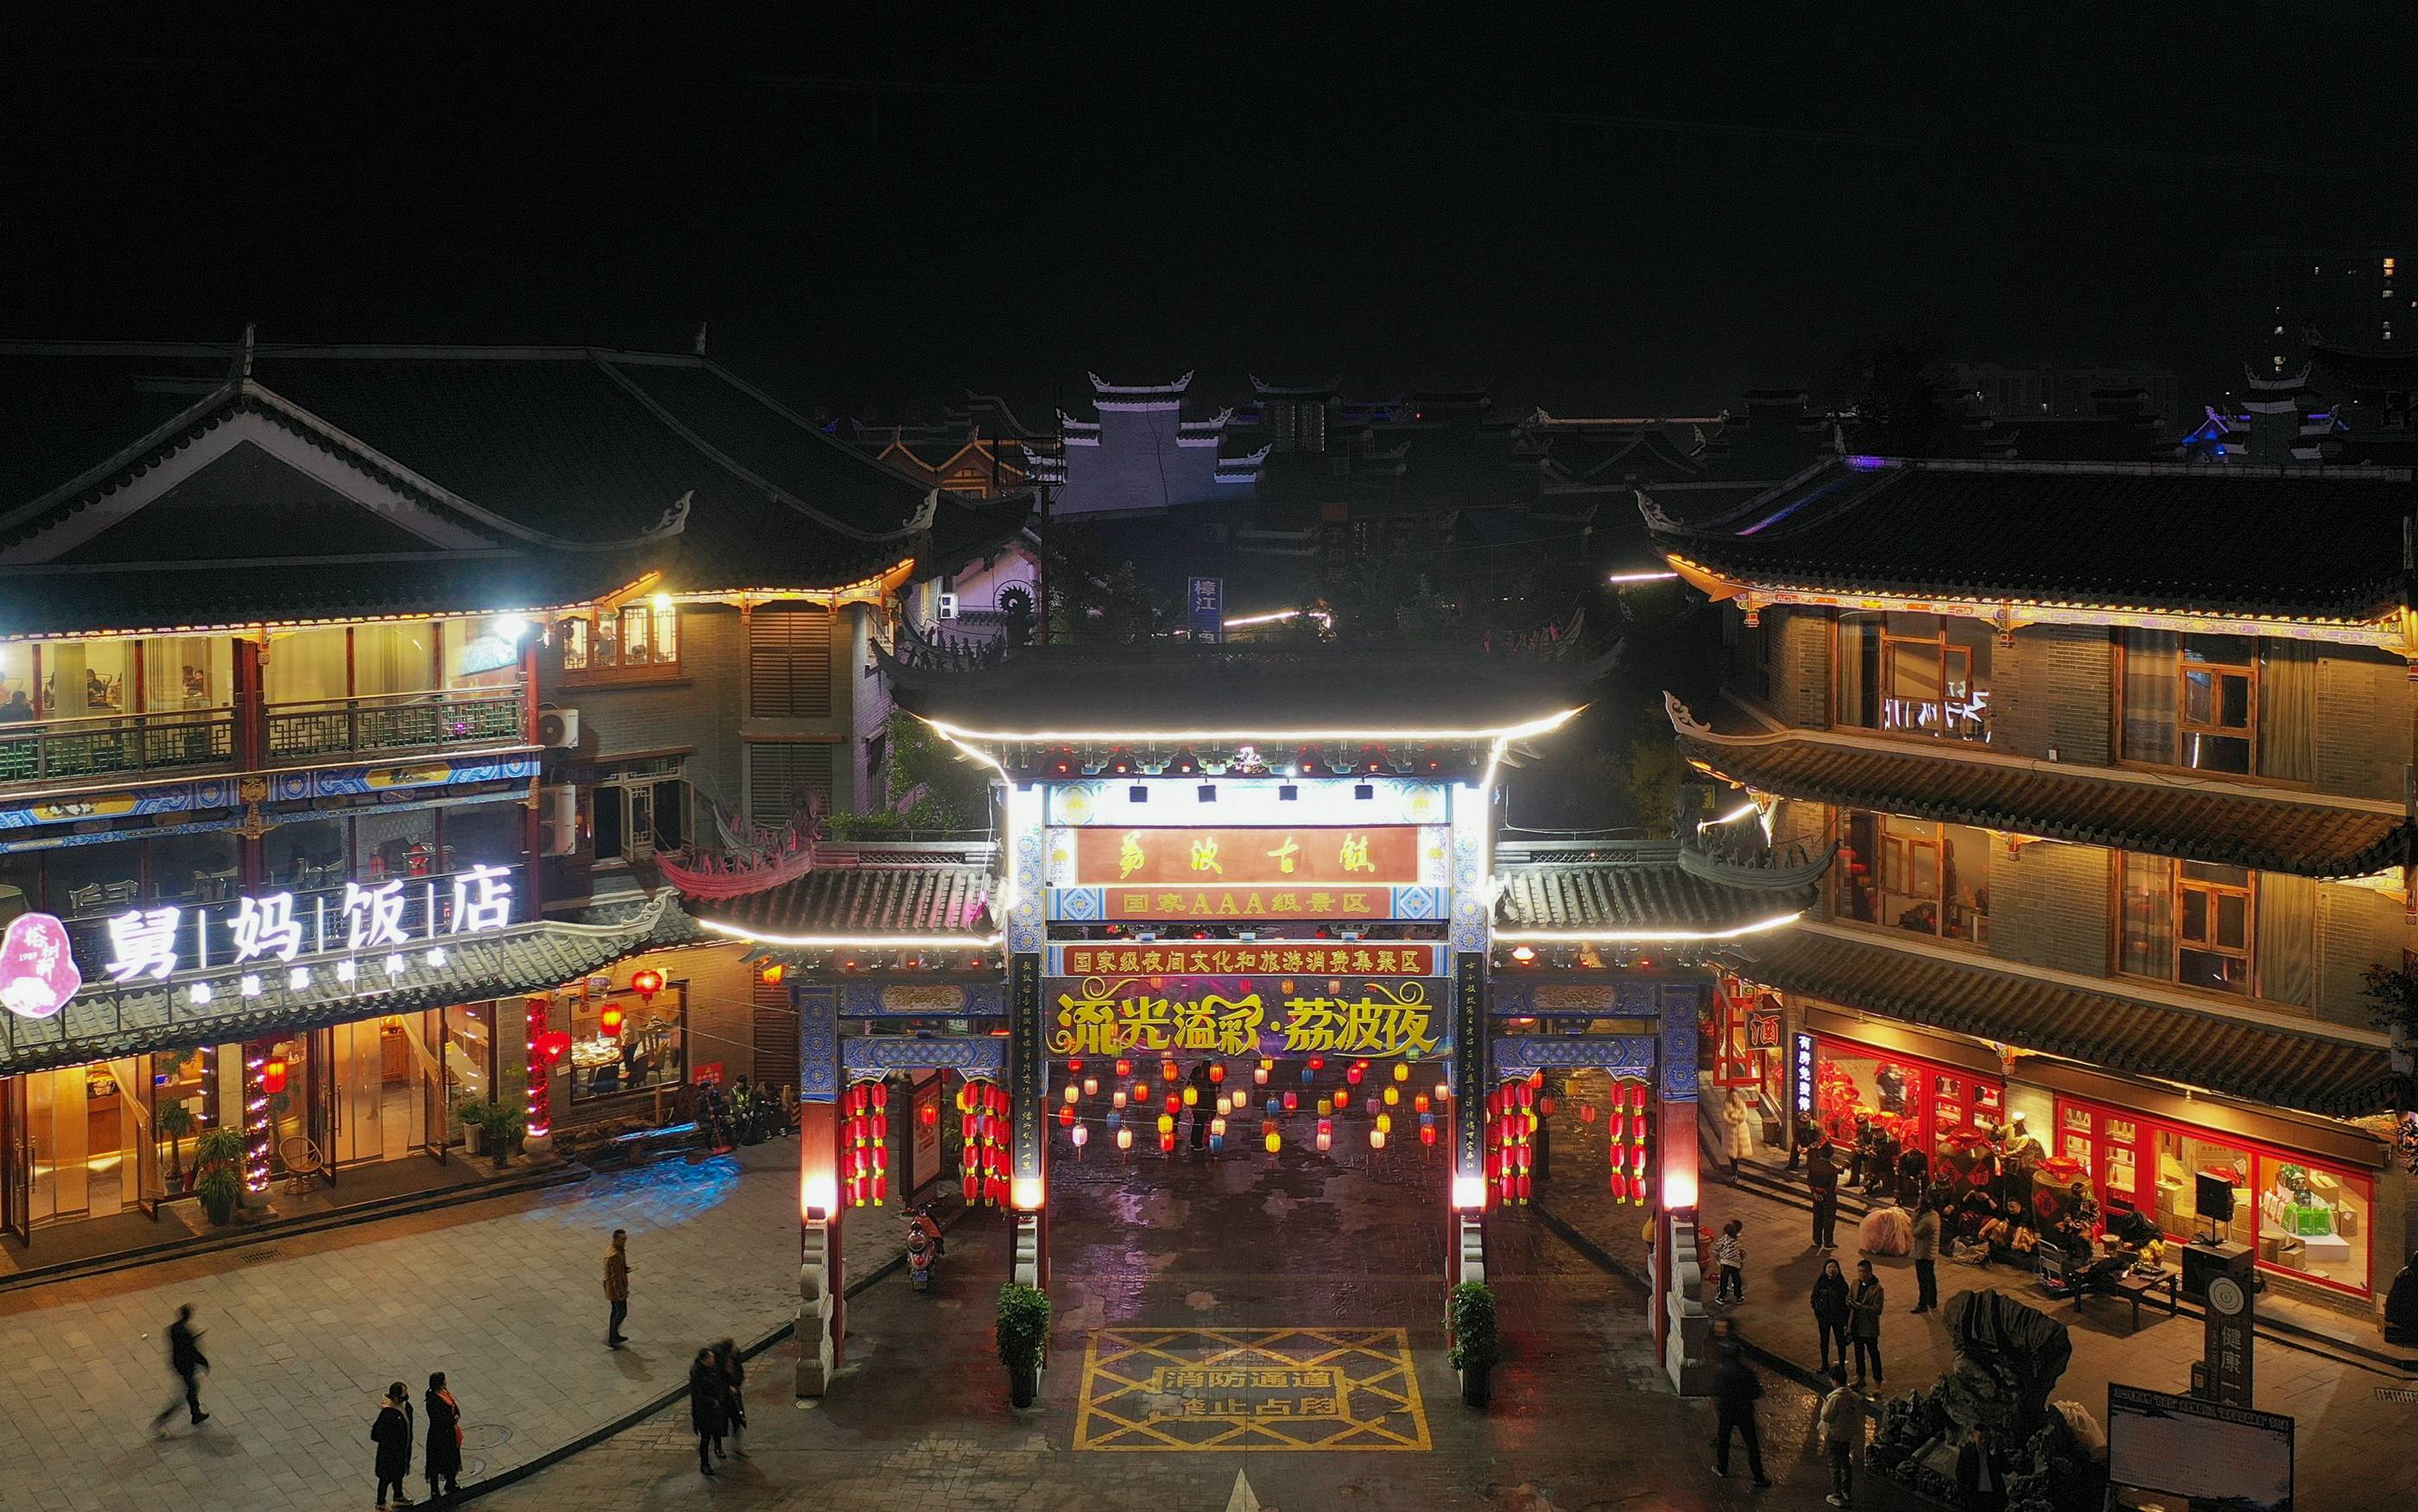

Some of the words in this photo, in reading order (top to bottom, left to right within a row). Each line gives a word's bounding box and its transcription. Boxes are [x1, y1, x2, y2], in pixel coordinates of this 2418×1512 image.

[1123, 892, 1372, 915] 国家AAA级景区
[105, 864, 513, 984] 舅妈饭店
[1073, 949, 1422, 974] 国家级夜间文化和旅游消费集聚区
[1045, 976, 1440, 1058] 流光溢彩·荔波夜
[1750, 1013, 1782, 1047] 酒
[1165, 1370, 1333, 1389] 消防通道
